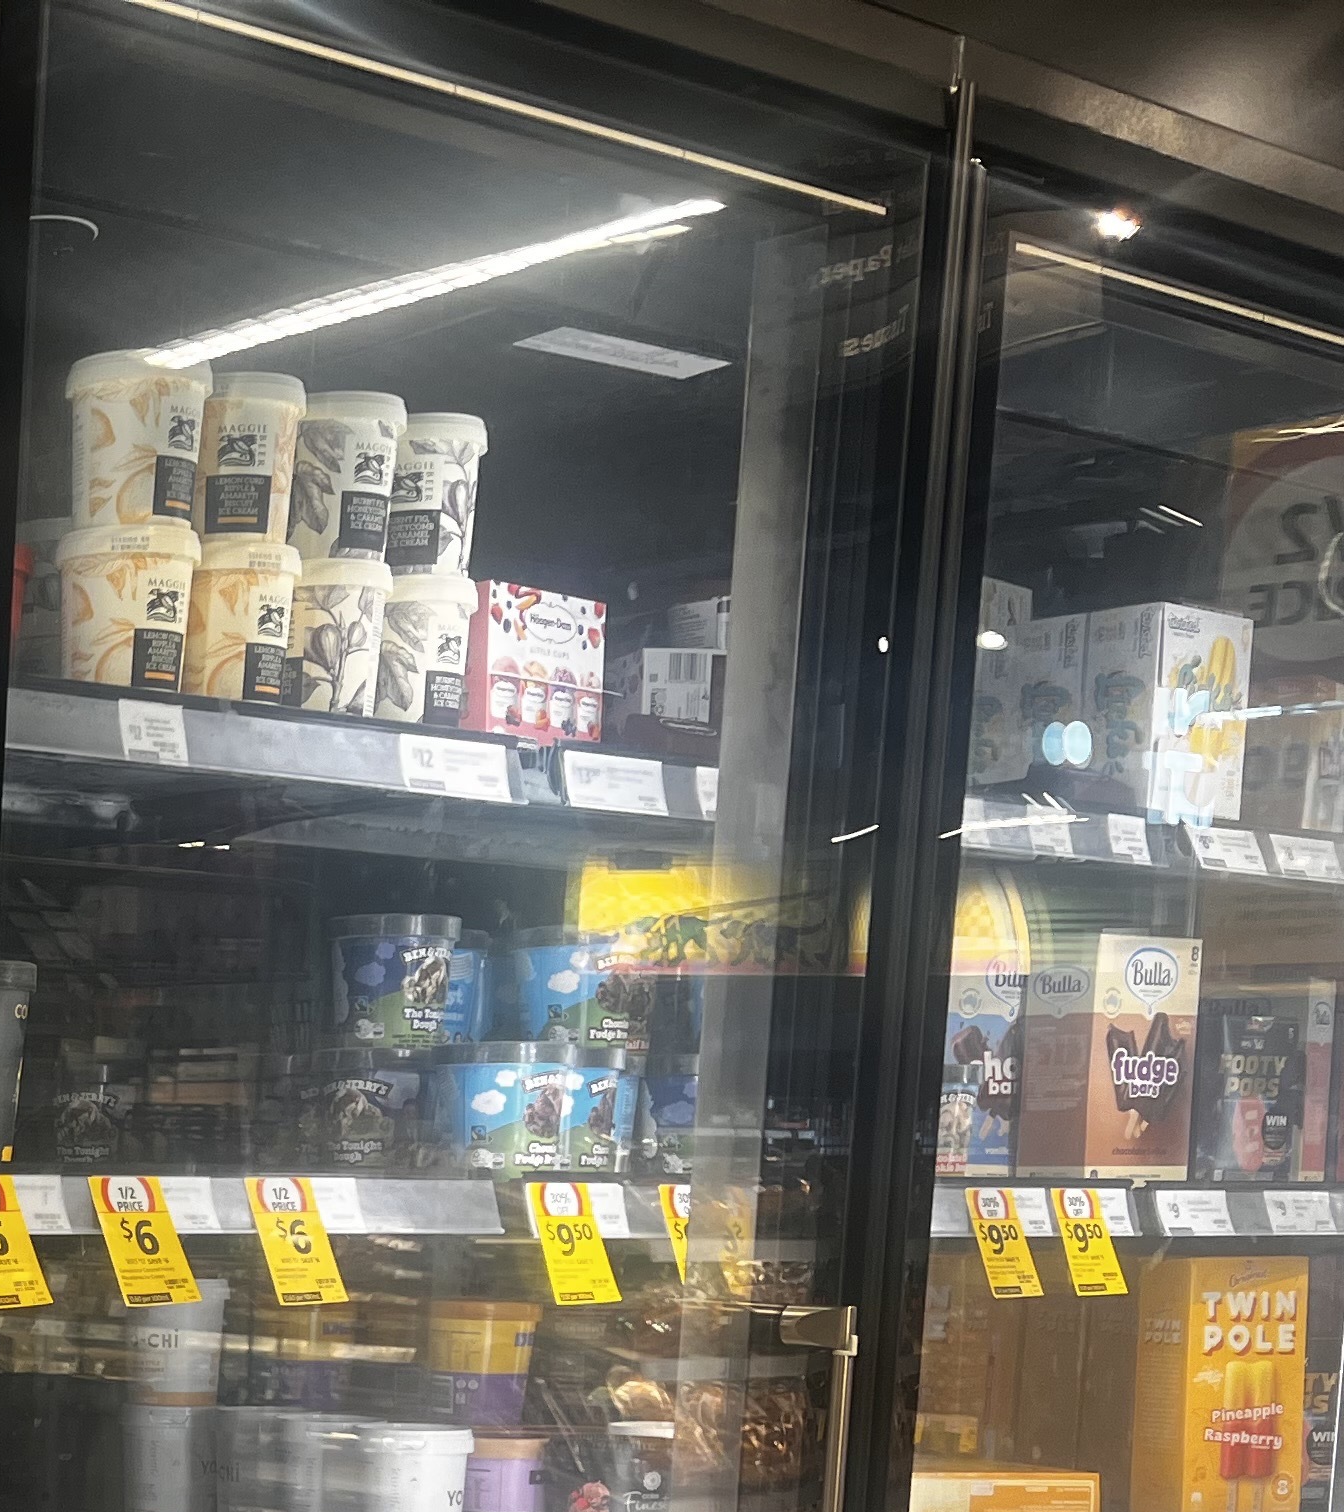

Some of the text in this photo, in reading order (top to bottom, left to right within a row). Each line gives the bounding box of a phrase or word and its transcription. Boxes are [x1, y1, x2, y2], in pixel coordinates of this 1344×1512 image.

[217, 423, 267, 435] MAGGIE
[1132, 958, 1172, 988] Bulla
[1111, 1050, 1179, 1086] fudge
[1219, 1054, 1286, 1076] FOOTY
[1128, 1080, 1159, 1098] bars
[1225, 1075, 1278, 1097] POPS
[1265, 1116, 1287, 1127] WIN
[118, 1185, 138, 1199] 1/2
[116, 1198, 145, 1213] PRICE
[1201, 1291, 1297, 1321] TWIN
[1201, 1324, 1296, 1355] POLE
[1211, 1403, 1284, 1423] Pineapple
[1203, 1428, 1283, 1450] Raspberry
